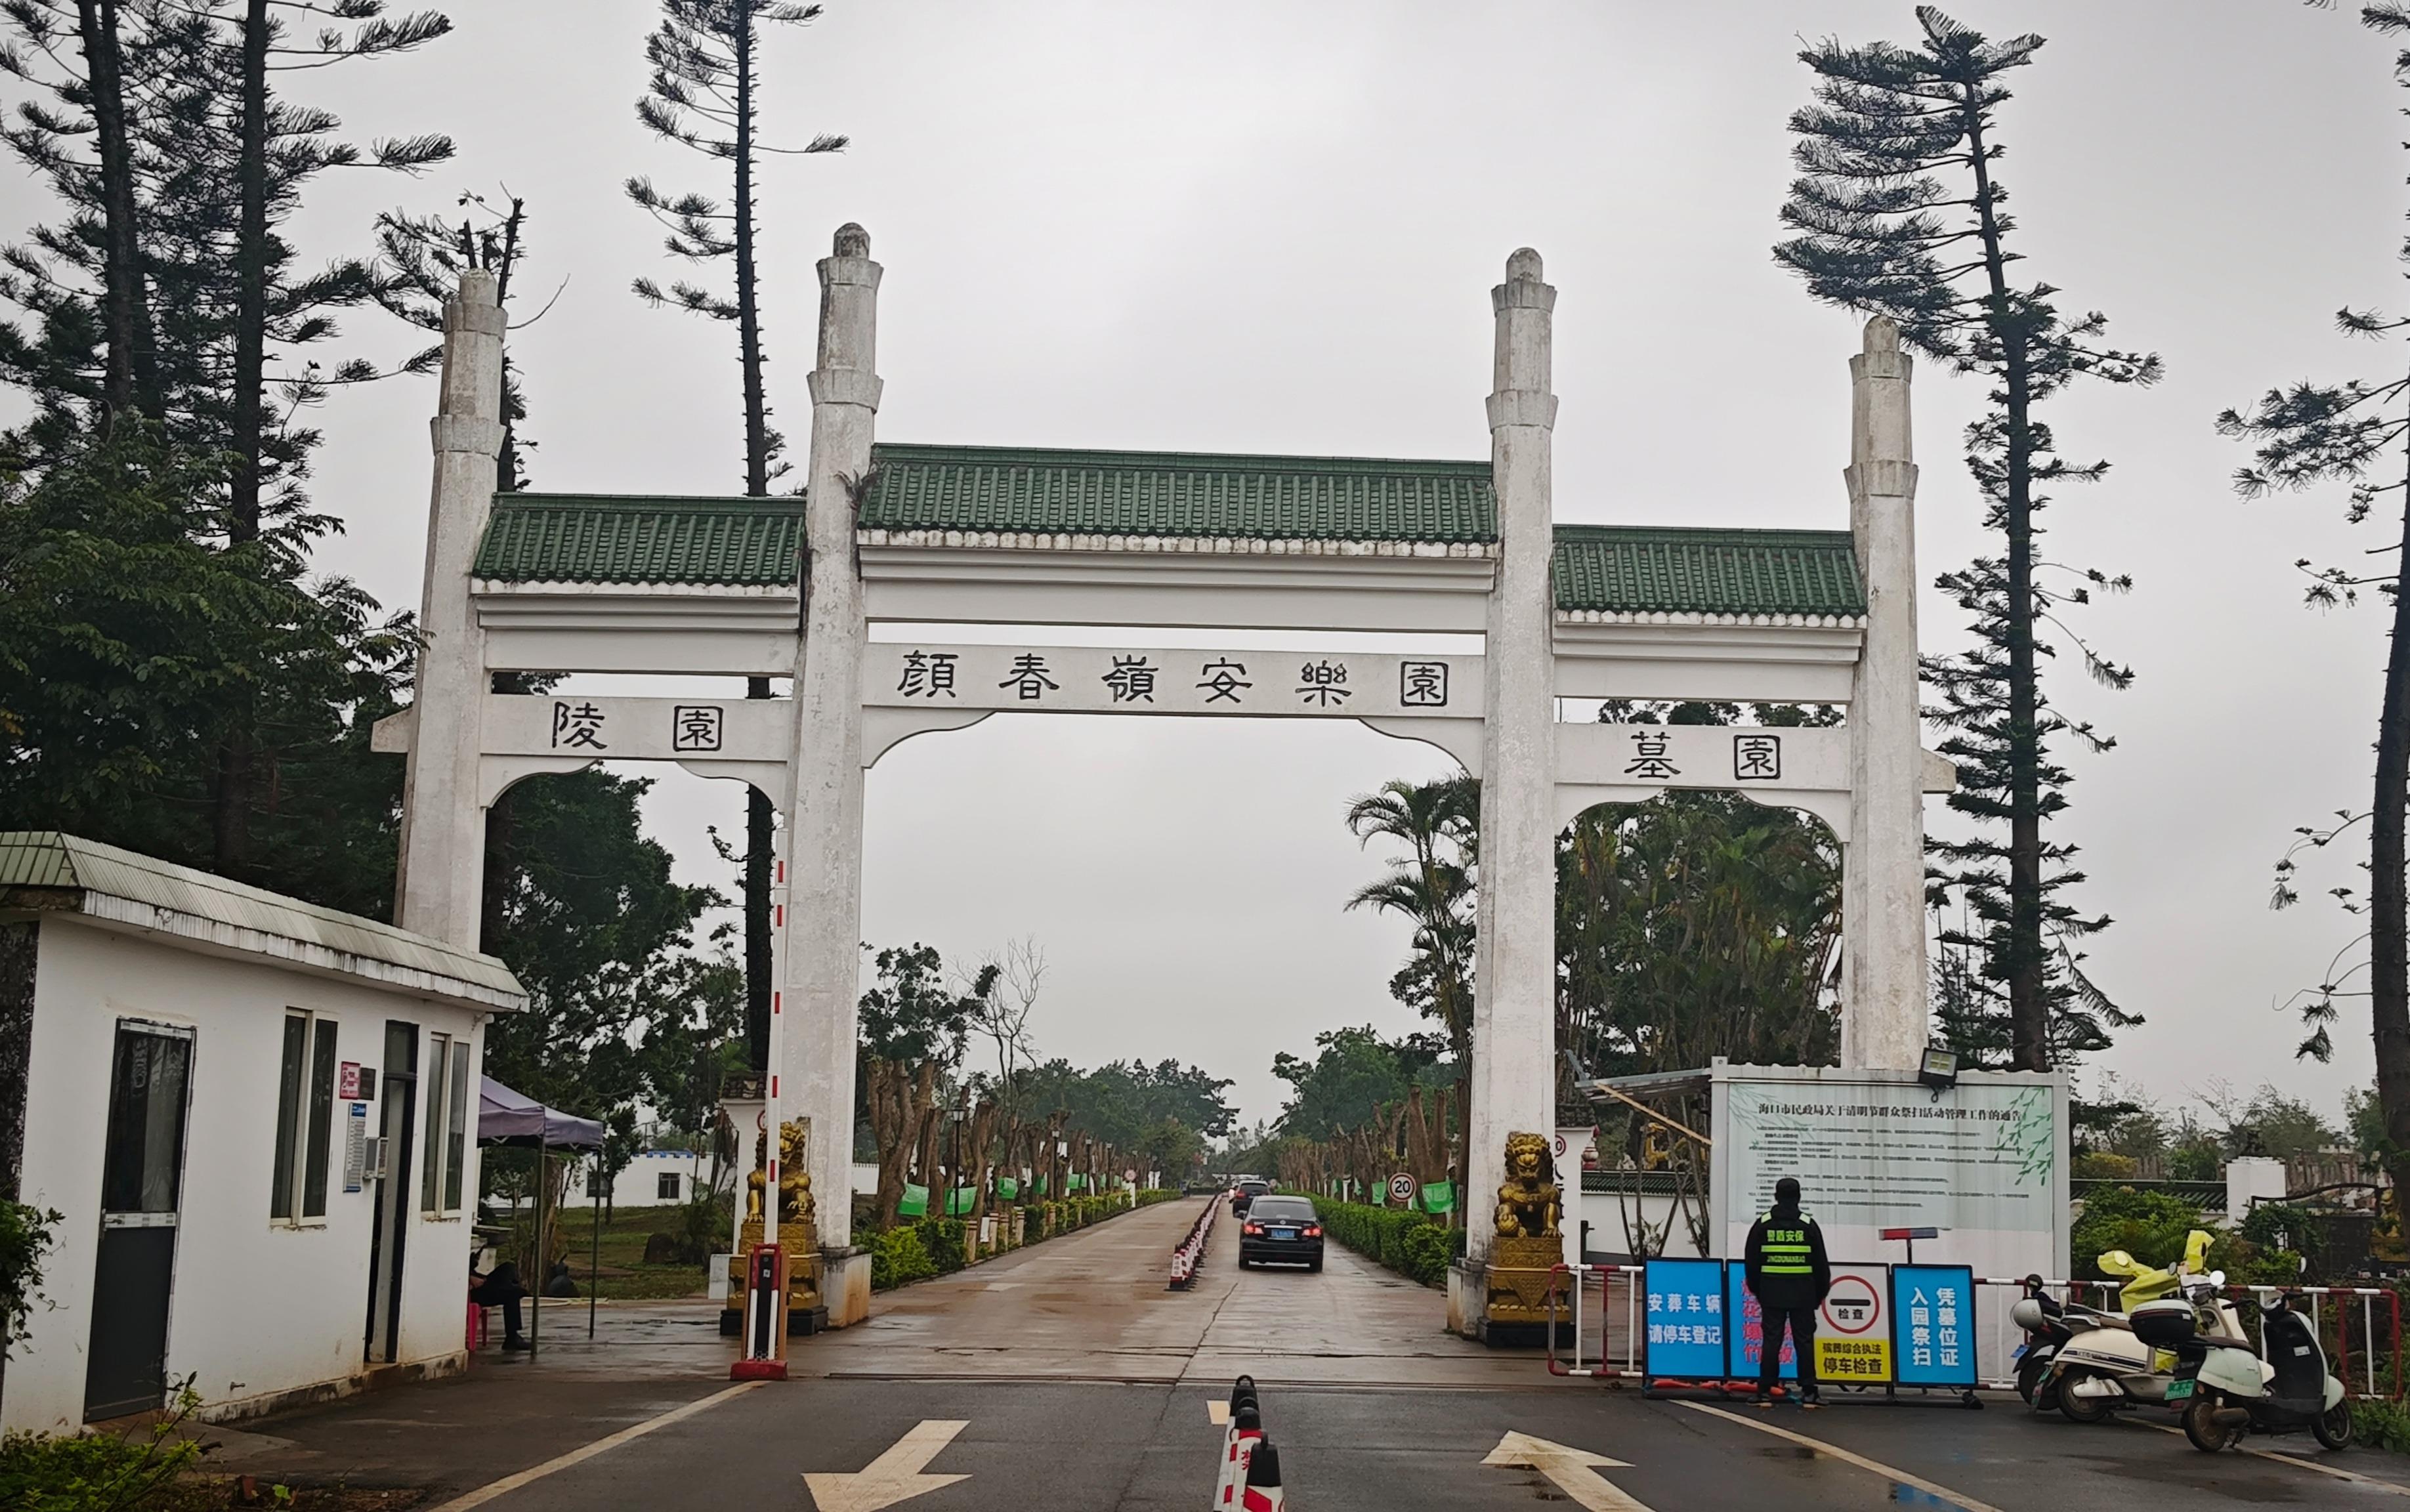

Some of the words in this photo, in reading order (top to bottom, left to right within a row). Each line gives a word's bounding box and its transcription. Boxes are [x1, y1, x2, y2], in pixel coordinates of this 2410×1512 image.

[552, 702, 723, 751] 陵園
[1624, 731, 1781, 780] 墓園
[1395, 1180, 1410, 1193] 20
[1648, 1293, 1721, 1313] 安葬车辆
[1838, 1309, 1864, 1320] 检查
[1649, 1324, 1722, 1344] 请停车登记
[1911, 1287, 1931, 1366] 入园祭扫
[1937, 1288, 1959, 1366] 凭墓位证
[1823, 1343, 1882, 1354] 殡葬综合执法
[1823, 1357, 1882, 1374] 停车检查
